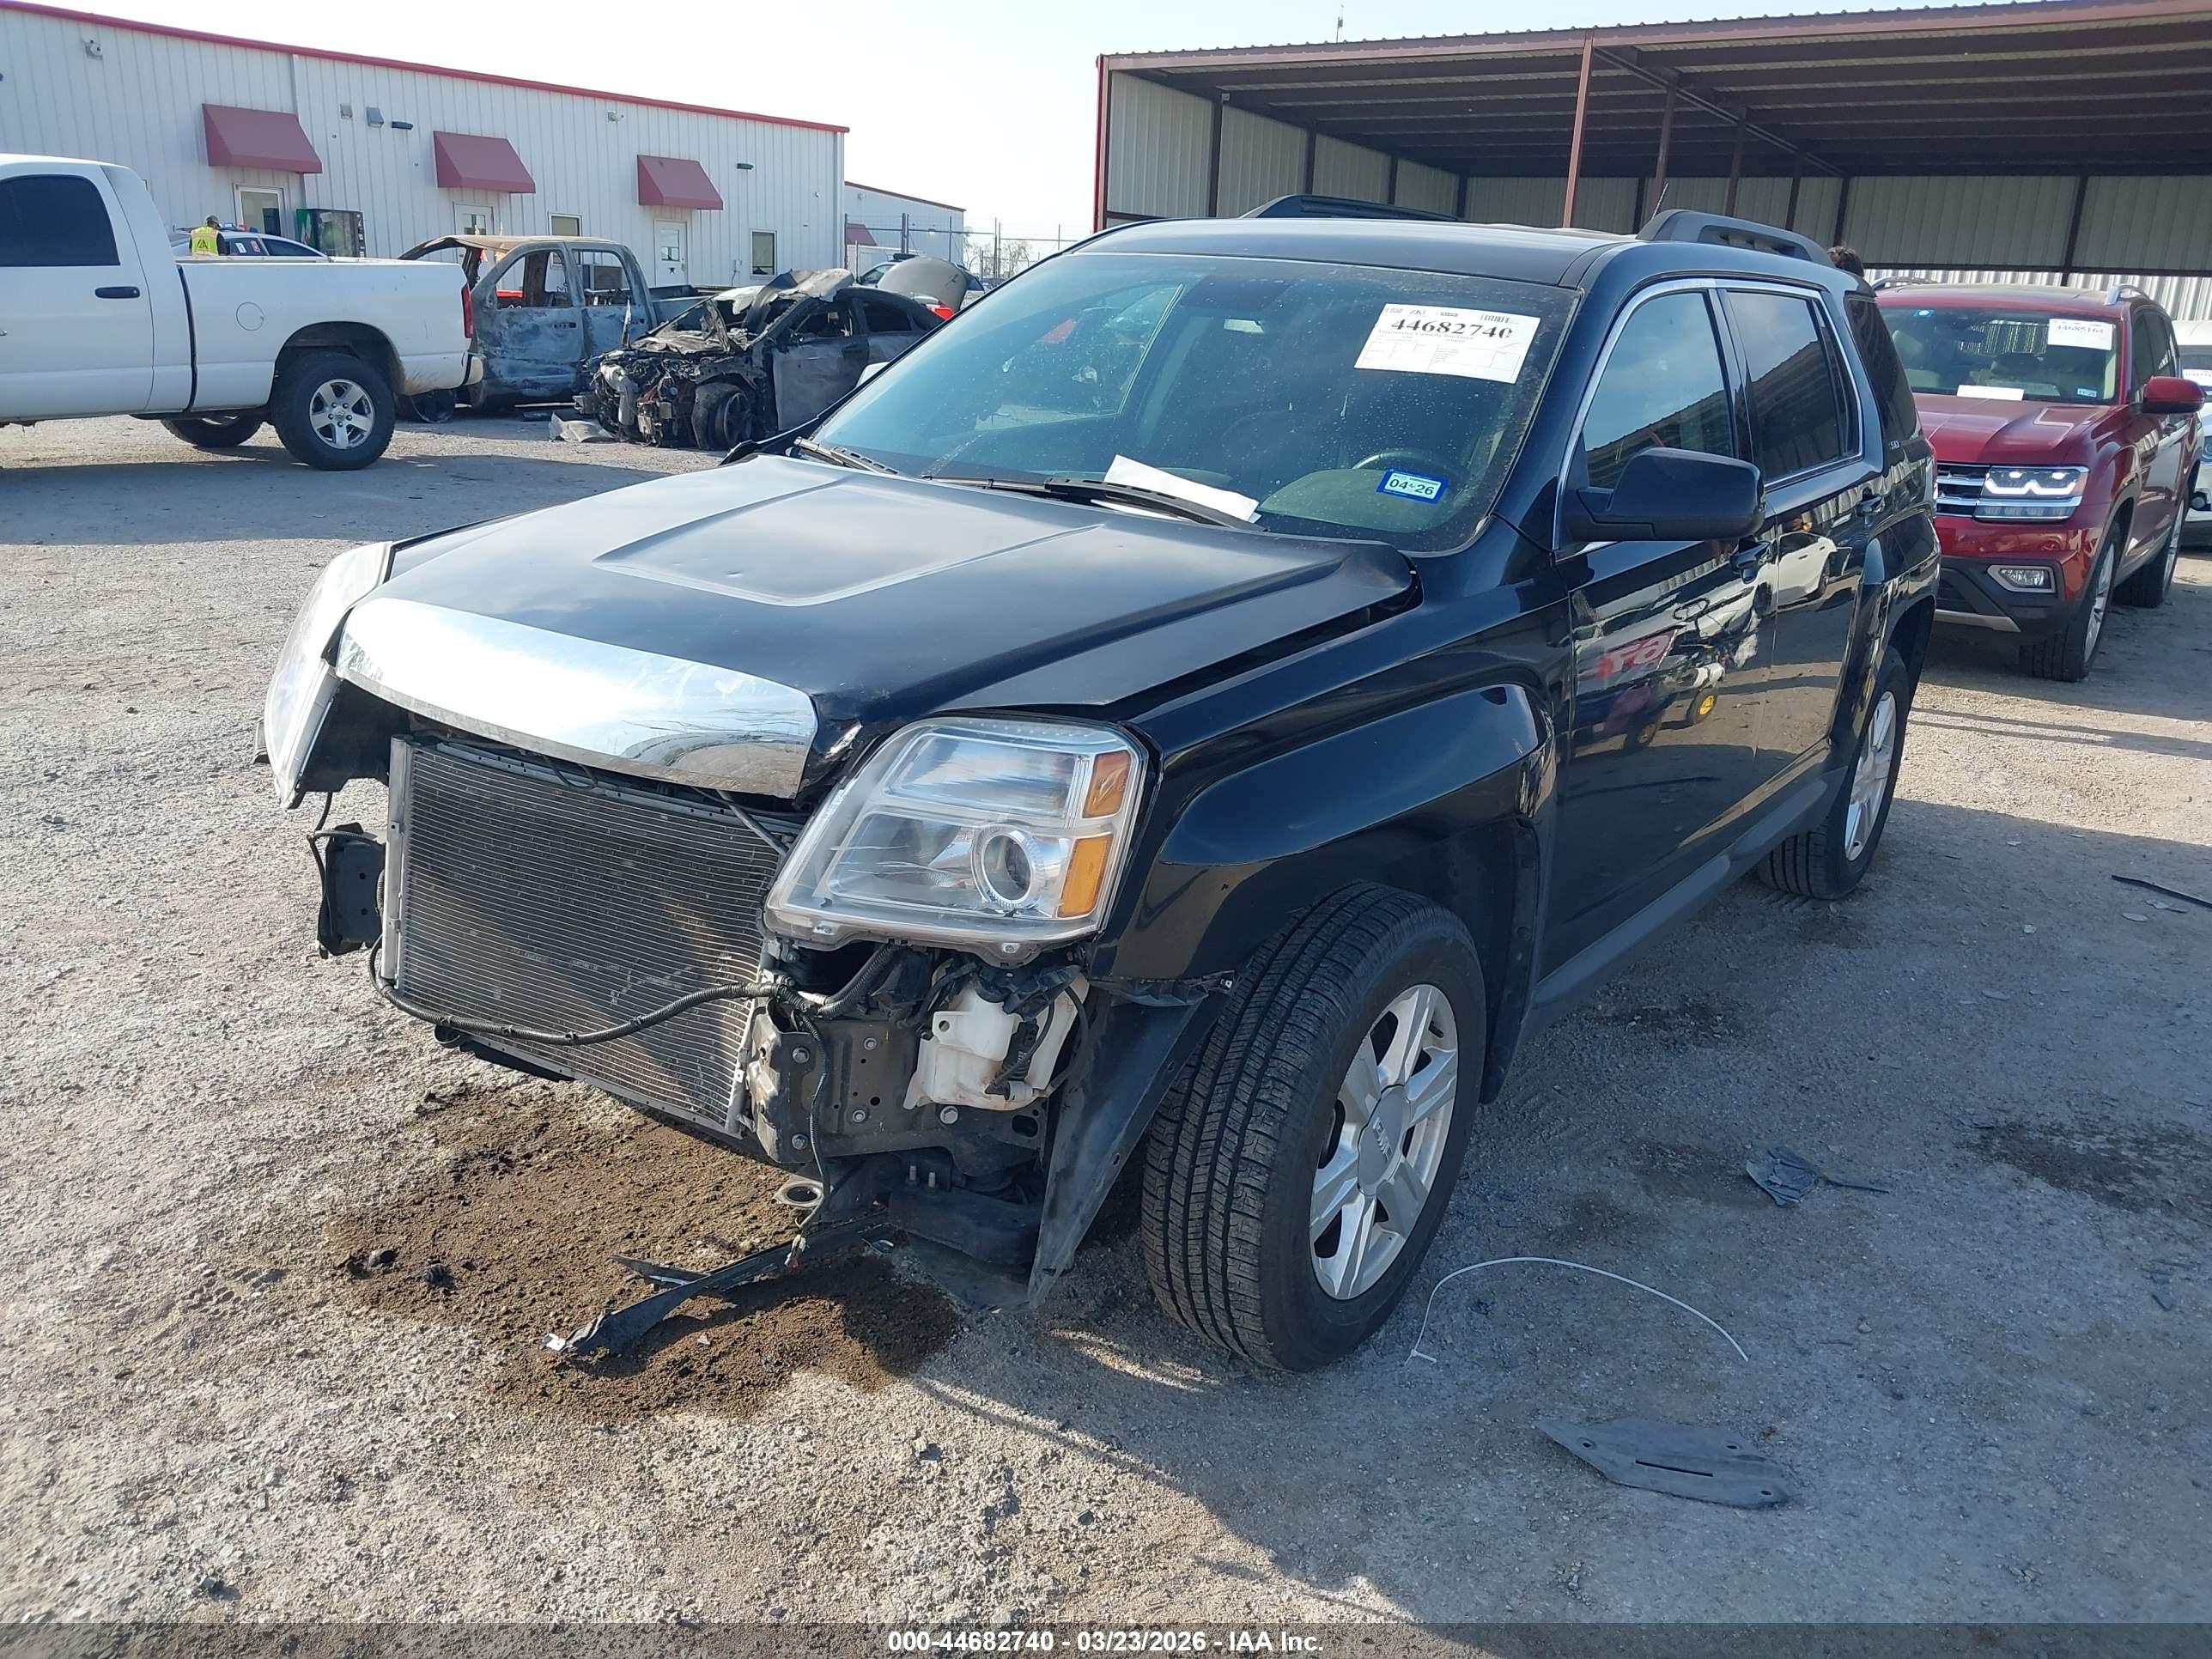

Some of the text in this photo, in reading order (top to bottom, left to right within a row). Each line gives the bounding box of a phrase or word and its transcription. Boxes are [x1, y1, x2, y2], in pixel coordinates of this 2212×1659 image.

[1391, 318, 1513, 339] 44682740
[1389, 478, 1435, 495] 04 26
